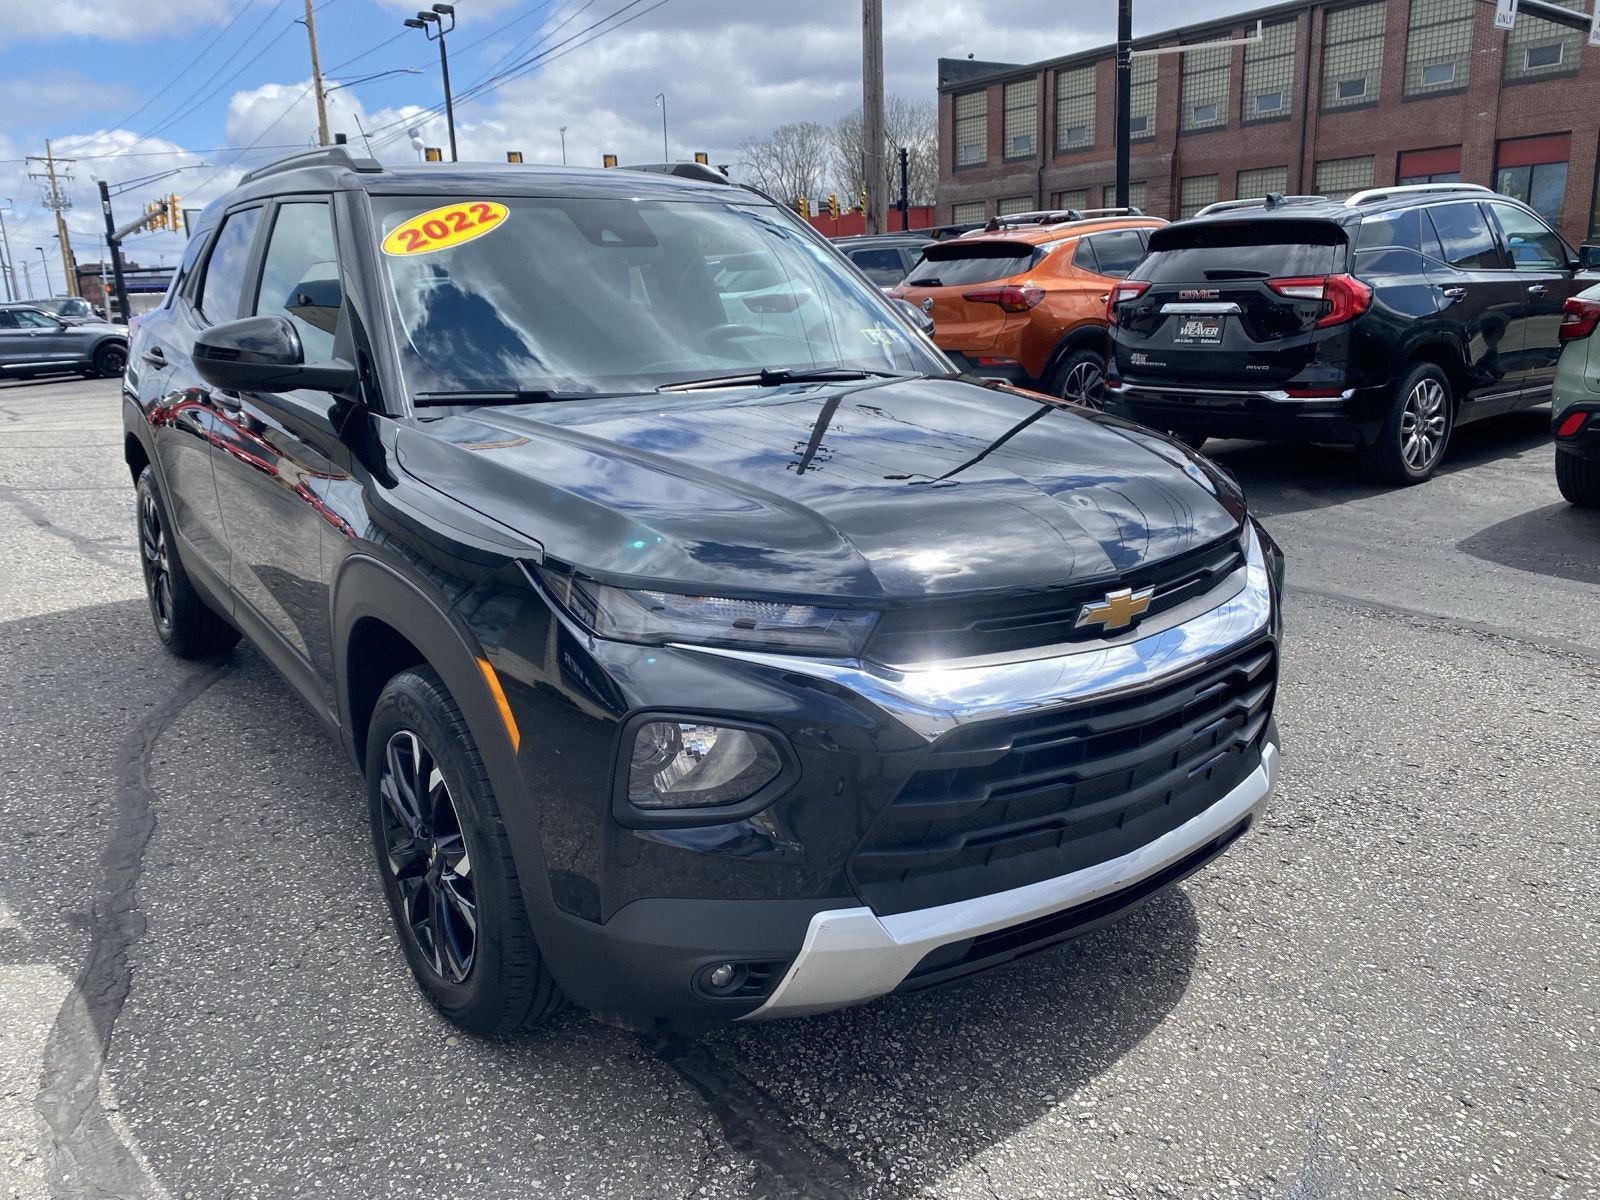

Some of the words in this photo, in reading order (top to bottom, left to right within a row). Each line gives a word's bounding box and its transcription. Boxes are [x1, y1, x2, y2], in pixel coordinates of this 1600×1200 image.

[1497, 12, 1514, 24] ONLY
[397, 203, 499, 252] 2022
[1179, 289, 1219, 299] GMC
[1180, 327, 1219, 335] WEAVER
